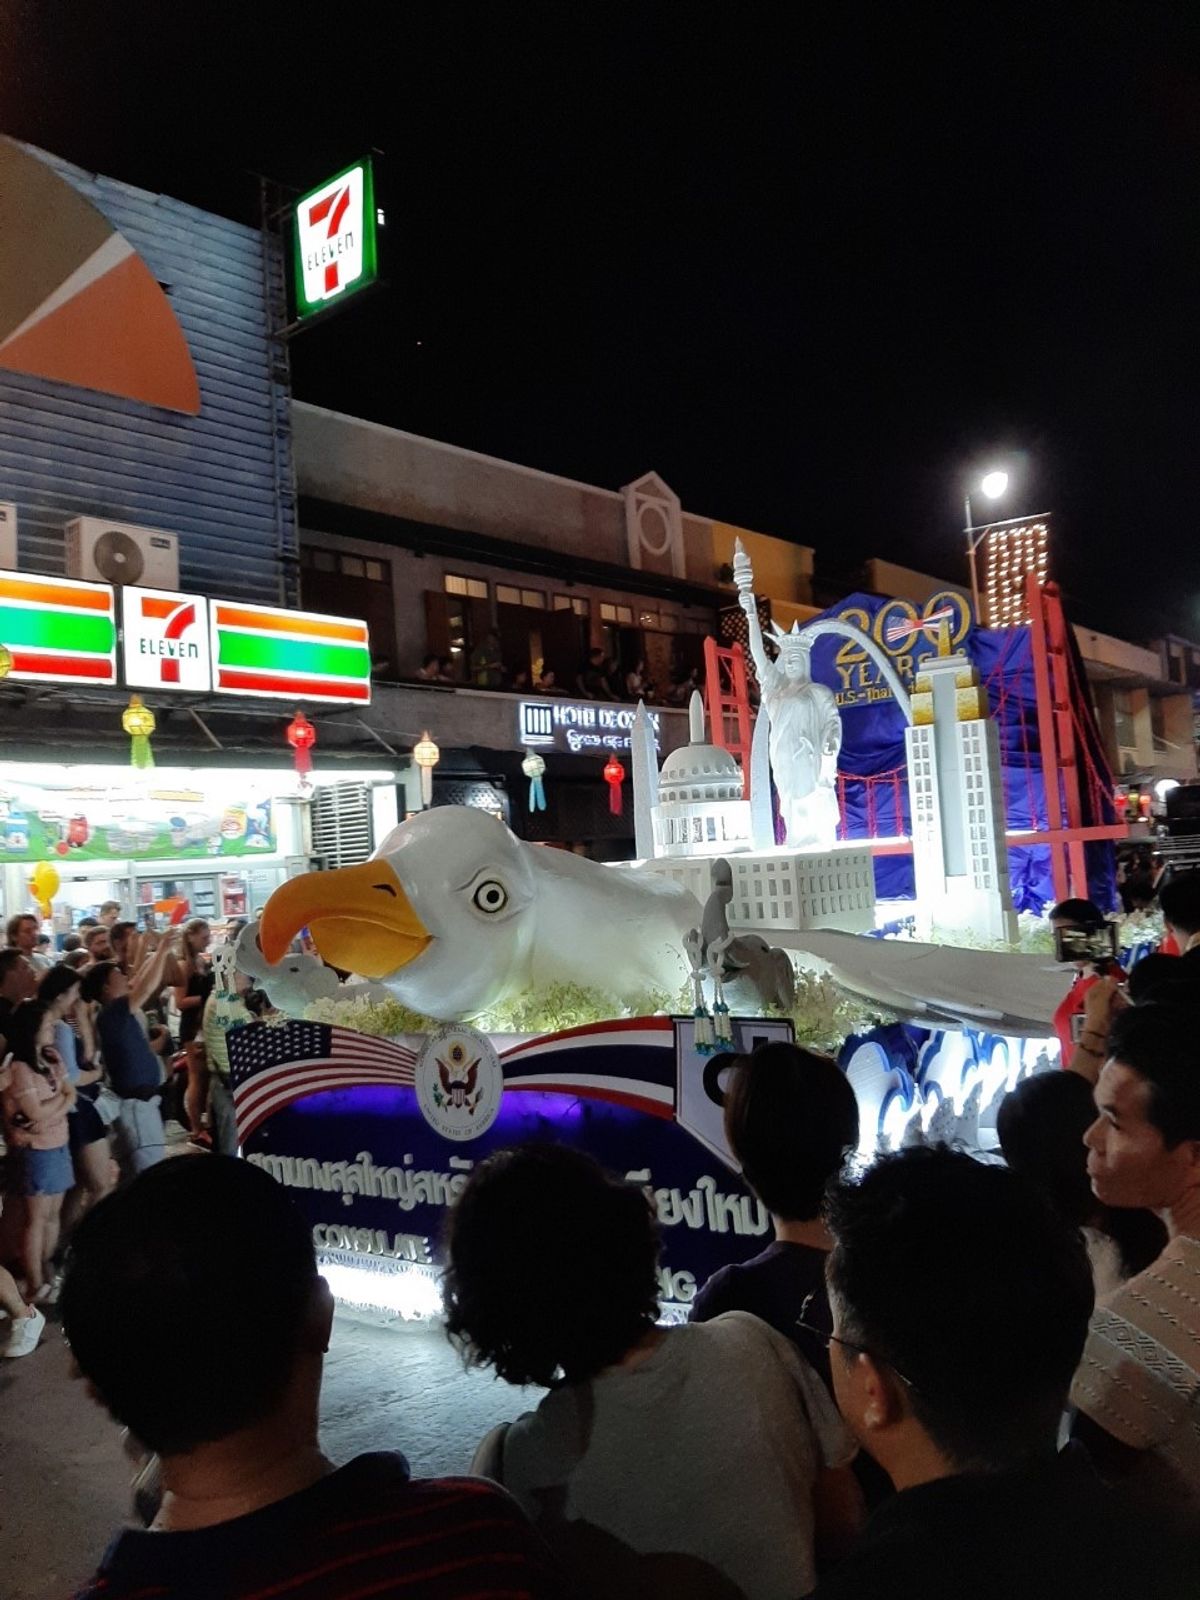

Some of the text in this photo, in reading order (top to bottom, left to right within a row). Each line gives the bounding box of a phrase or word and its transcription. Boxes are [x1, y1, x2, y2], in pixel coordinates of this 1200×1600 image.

[308, 184, 352, 294] 7
[140, 596, 196, 683] 7
[836, 591, 971, 665] 200
[312, 1222, 433, 1264] CONSULATE
